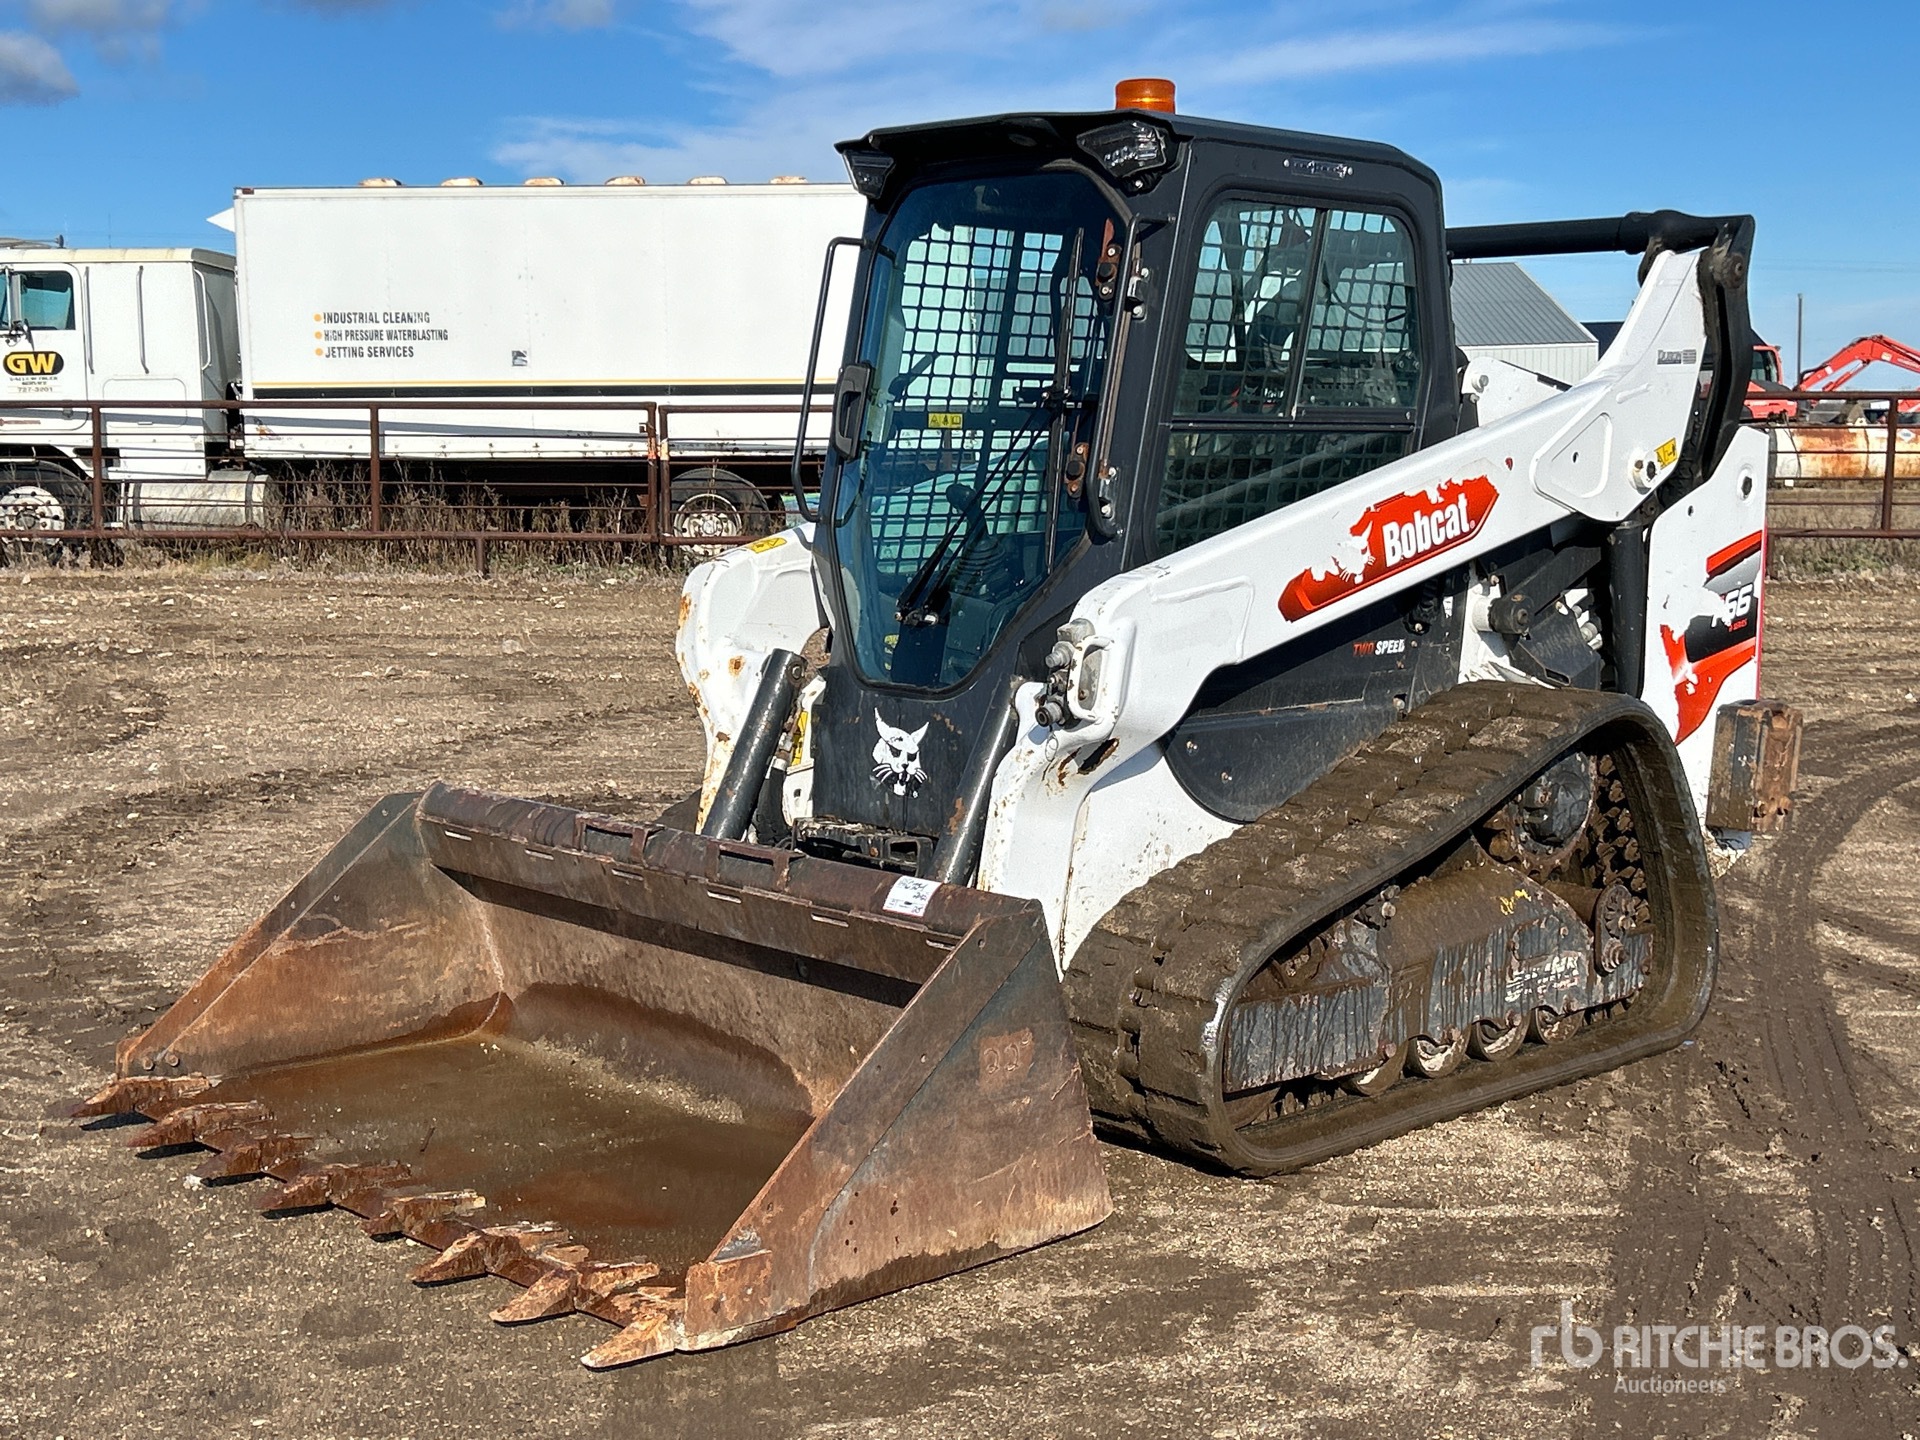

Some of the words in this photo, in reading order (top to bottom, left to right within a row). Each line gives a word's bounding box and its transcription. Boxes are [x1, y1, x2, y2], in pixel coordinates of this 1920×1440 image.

[323, 312, 380, 324] INDUSTRIAL
[382, 312, 431, 324] CLEANING
[324, 329, 343, 341] HIGH
[344, 329, 384, 341] PRESSURE
[386, 329, 449, 341] WATERBLASTING
[325, 346, 364, 358] JETTING
[367, 346, 414, 358] SERVICES
[6, 353, 57, 374] GW
[1382, 493, 1470, 567] Bobcat
[1353, 642, 1375, 656] TWO
[1375, 638, 1406, 655] SPEED
